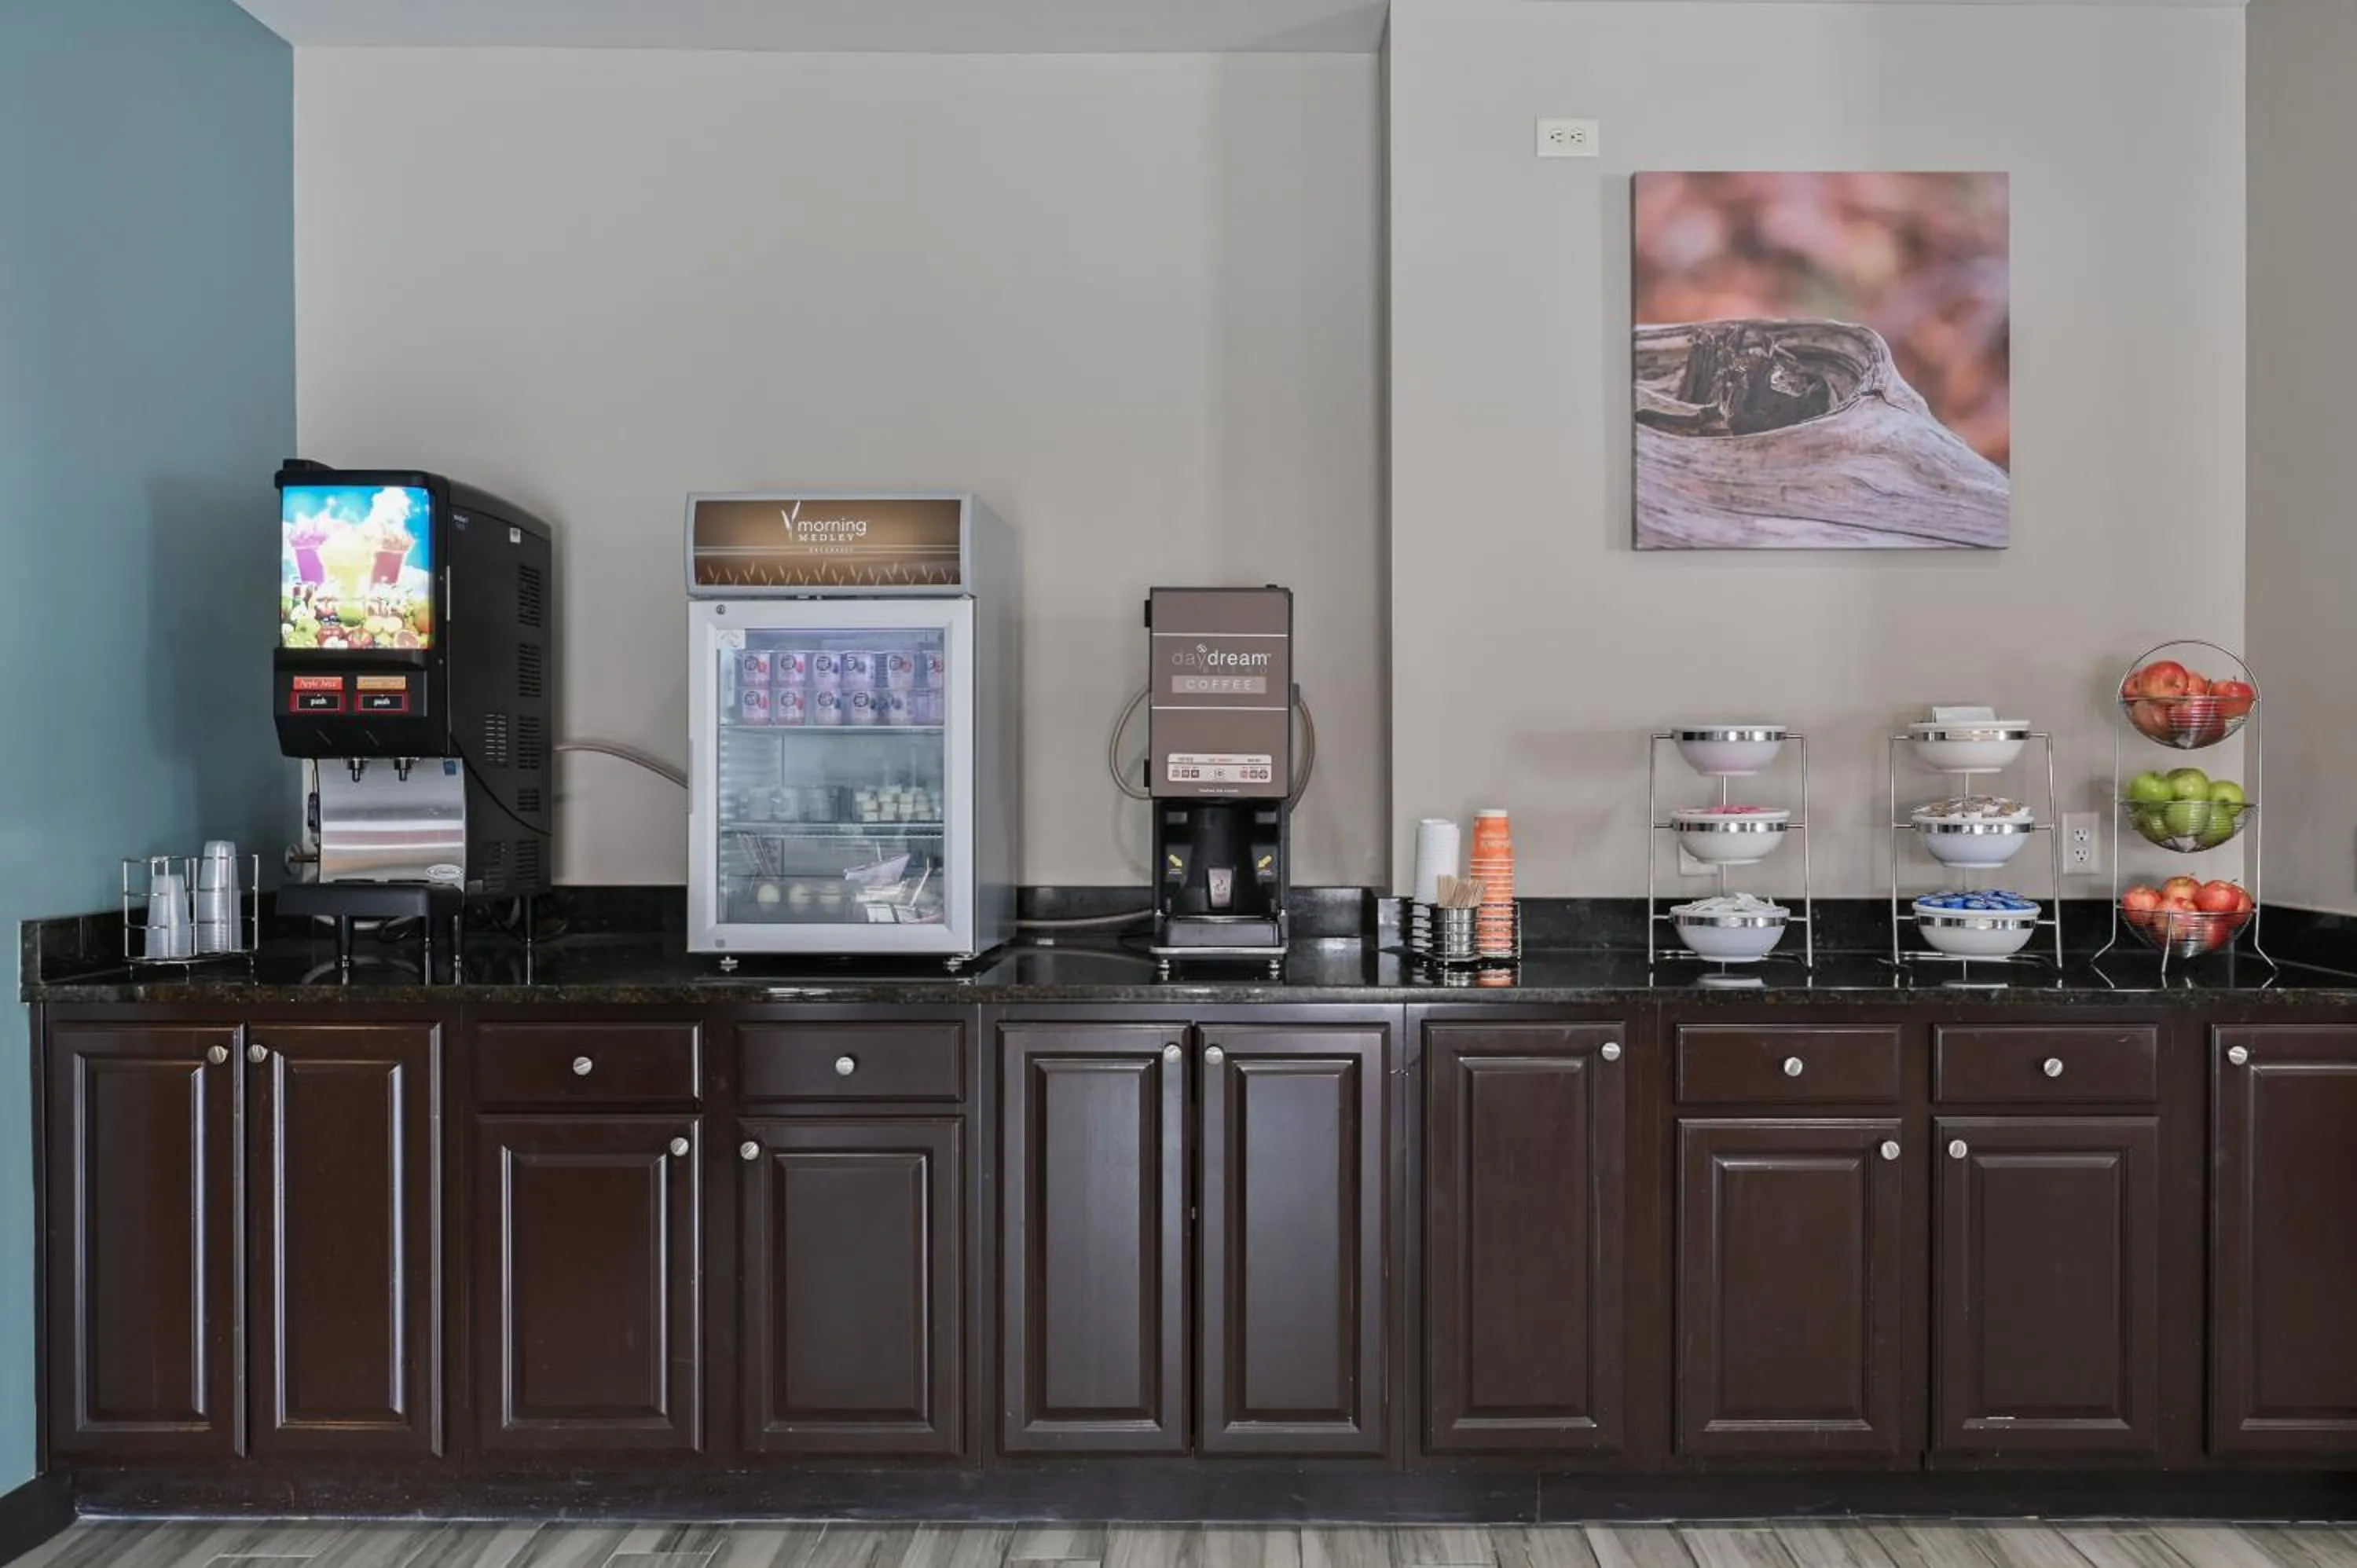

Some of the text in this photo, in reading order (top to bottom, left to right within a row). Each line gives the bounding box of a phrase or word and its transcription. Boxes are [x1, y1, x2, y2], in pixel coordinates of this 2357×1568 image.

[797, 518, 867, 537] morning
[798, 533, 855, 542] MEDLEY
[1171, 647, 1268, 672] daydream
[1186, 679, 1253, 691] COFFEE
[310, 698, 328, 707] push
[373, 698, 390, 707] push
